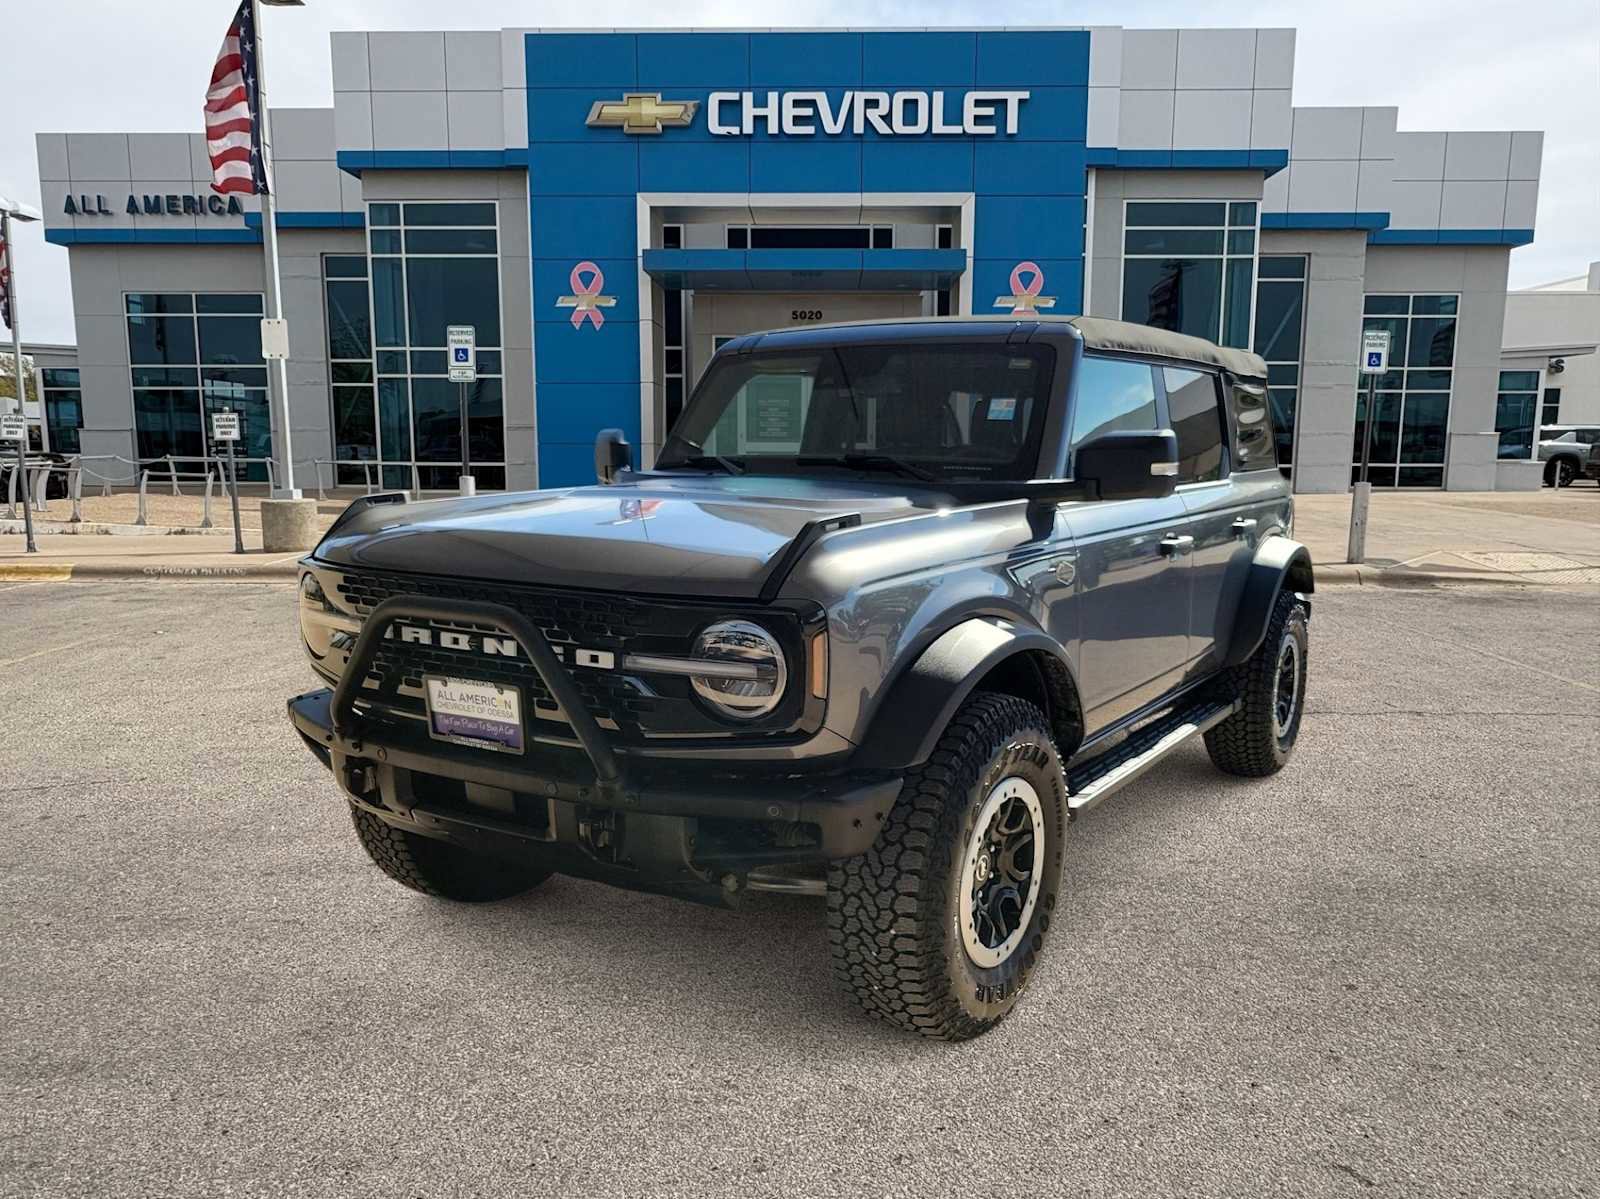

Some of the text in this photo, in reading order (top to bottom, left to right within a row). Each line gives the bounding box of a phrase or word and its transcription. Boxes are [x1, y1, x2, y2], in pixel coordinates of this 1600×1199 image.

[707, 90, 1031, 136] CHEVROLET
[64, 194, 112, 215] ALL
[791, 310, 823, 320] 5020
[384, 624, 615, 670] RONO
[436, 701, 475, 713] CHEVROLET
[487, 708, 515, 719] ODESSA
[438, 690, 513, 710] ALL AMERICN
